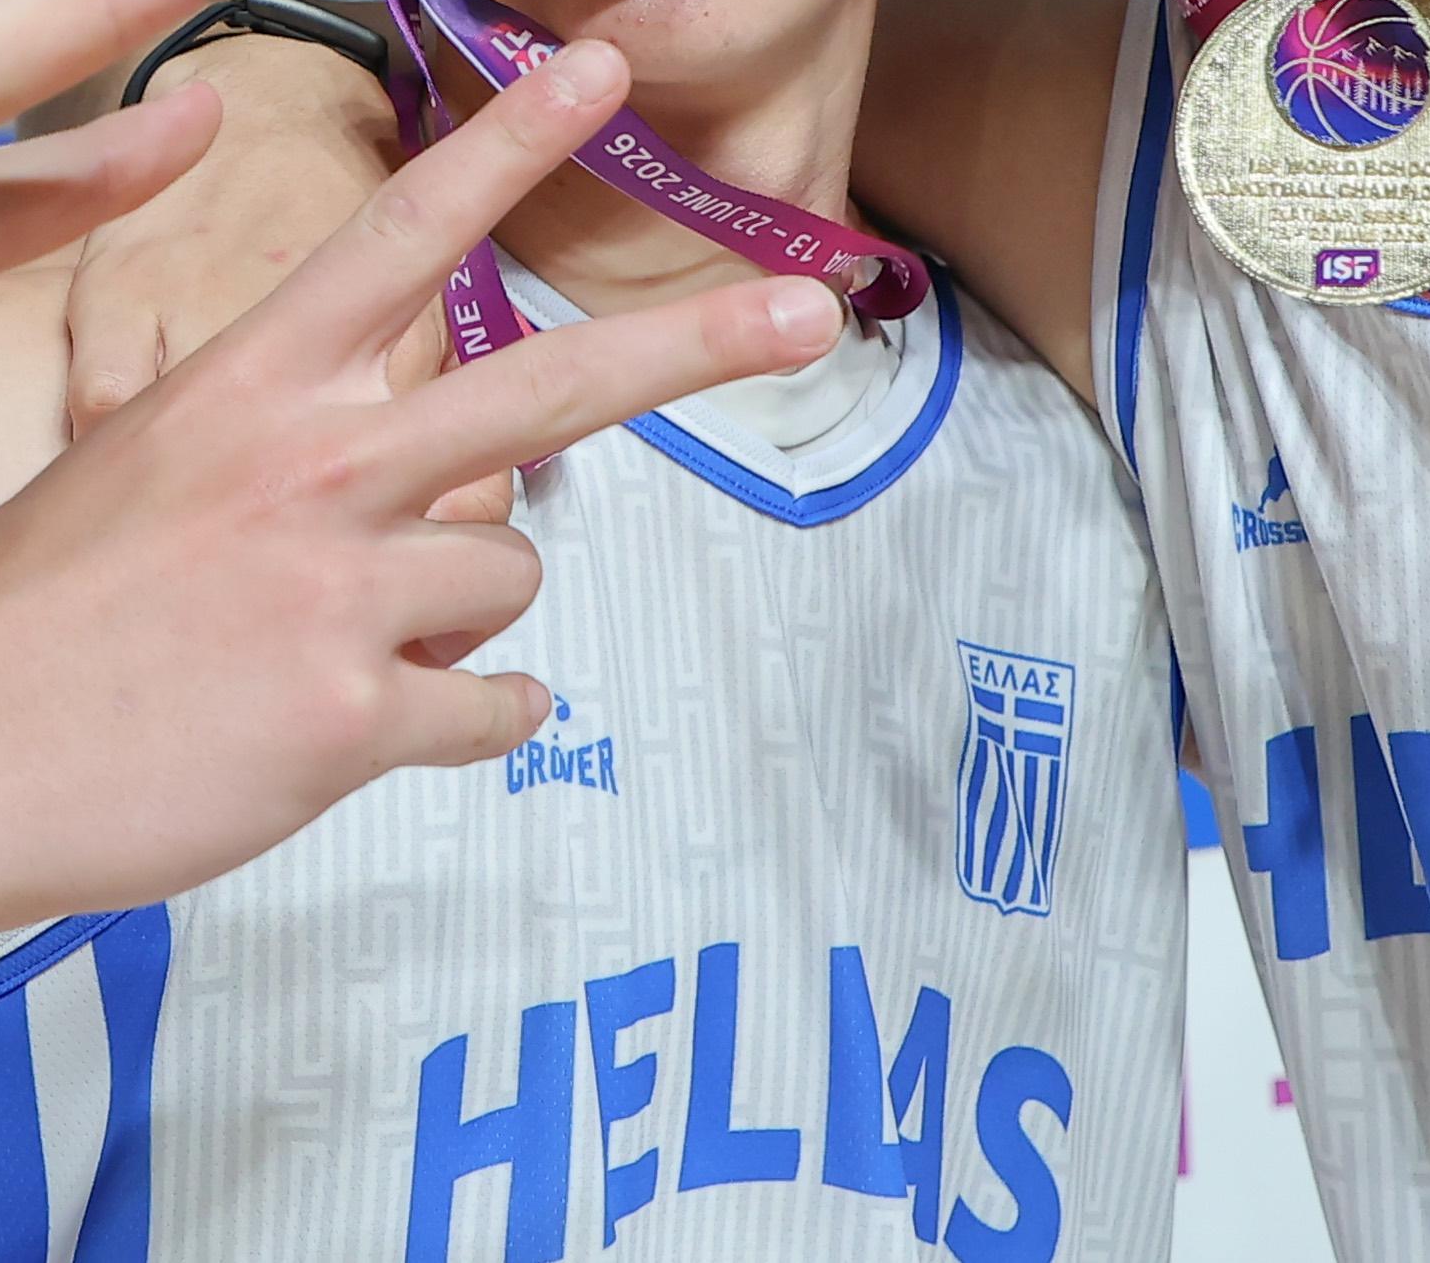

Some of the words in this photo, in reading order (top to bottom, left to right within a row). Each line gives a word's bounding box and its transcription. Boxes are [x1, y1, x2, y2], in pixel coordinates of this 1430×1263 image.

[603, 133, 683, 191] 2026
[1287, 157, 1357, 176] WORLD
[667, 185, 746, 223] JUNE
[731, 210, 775, 237] 22
[784, 233, 821, 263] 13
[1321, 255, 1374, 281] ISF
[1231, 501, 1309, 554] CROSS
[968, 653, 1061, 698] ΕΛΛΑΣ
[403, 942, 1073, 1263] HELLAS
